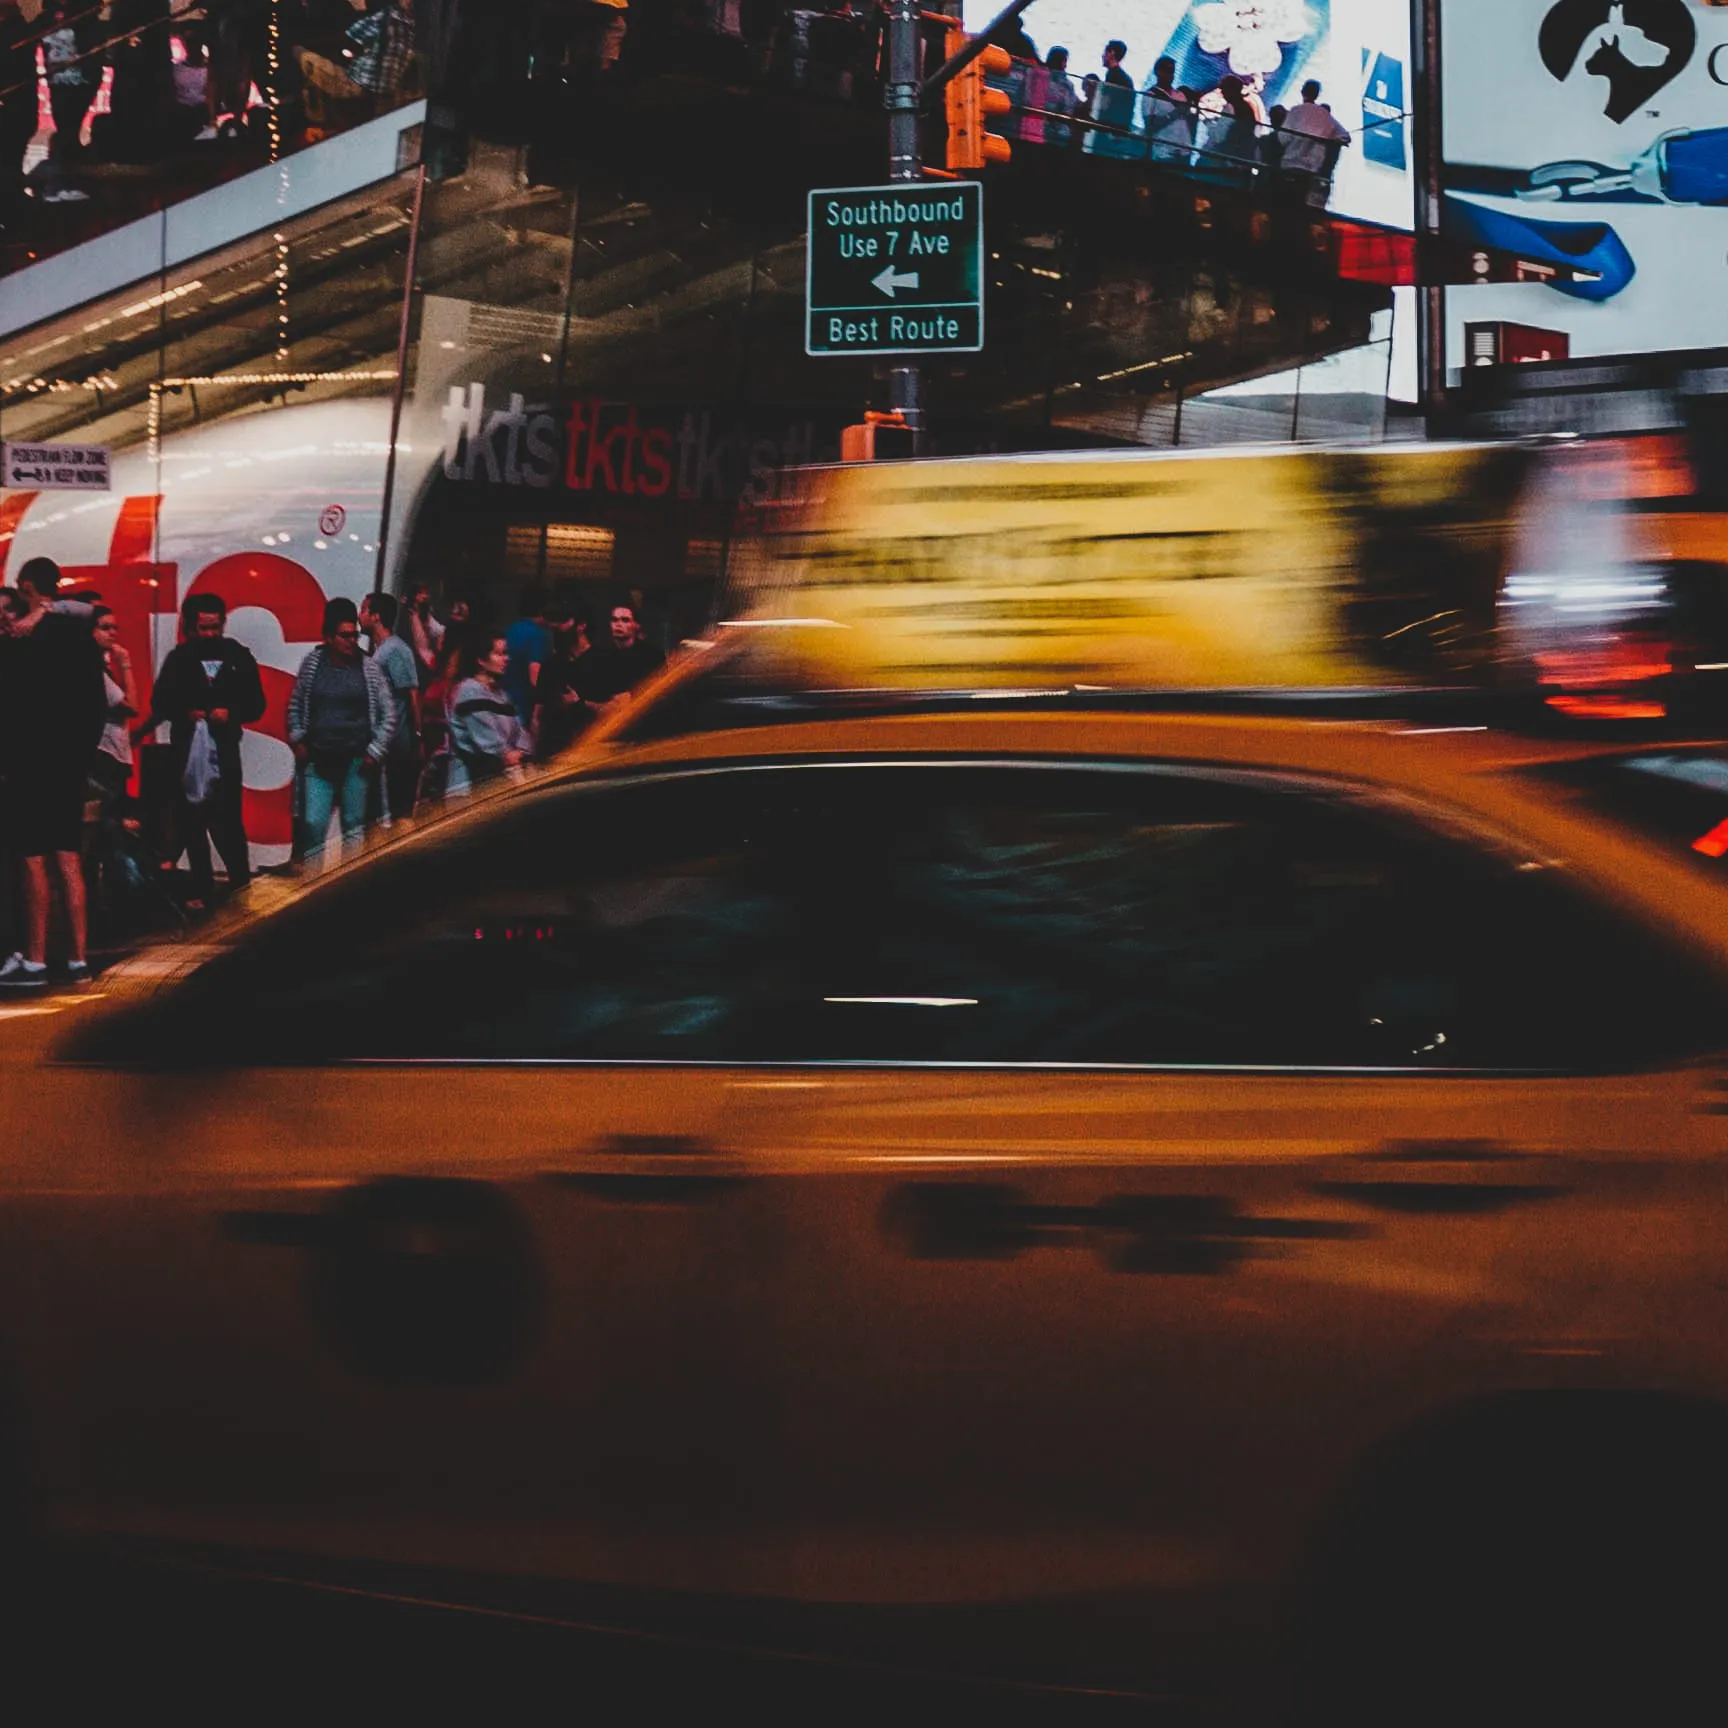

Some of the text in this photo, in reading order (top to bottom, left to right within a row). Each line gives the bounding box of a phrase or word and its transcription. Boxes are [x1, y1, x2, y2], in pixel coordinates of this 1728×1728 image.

[826, 196, 964, 227] Southbound
[839, 230, 950, 259] Use 7 Ave
[828, 315, 959, 342] Best Route
[442, 382, 559, 487] tkts
[565, 398, 672, 496] tkts
